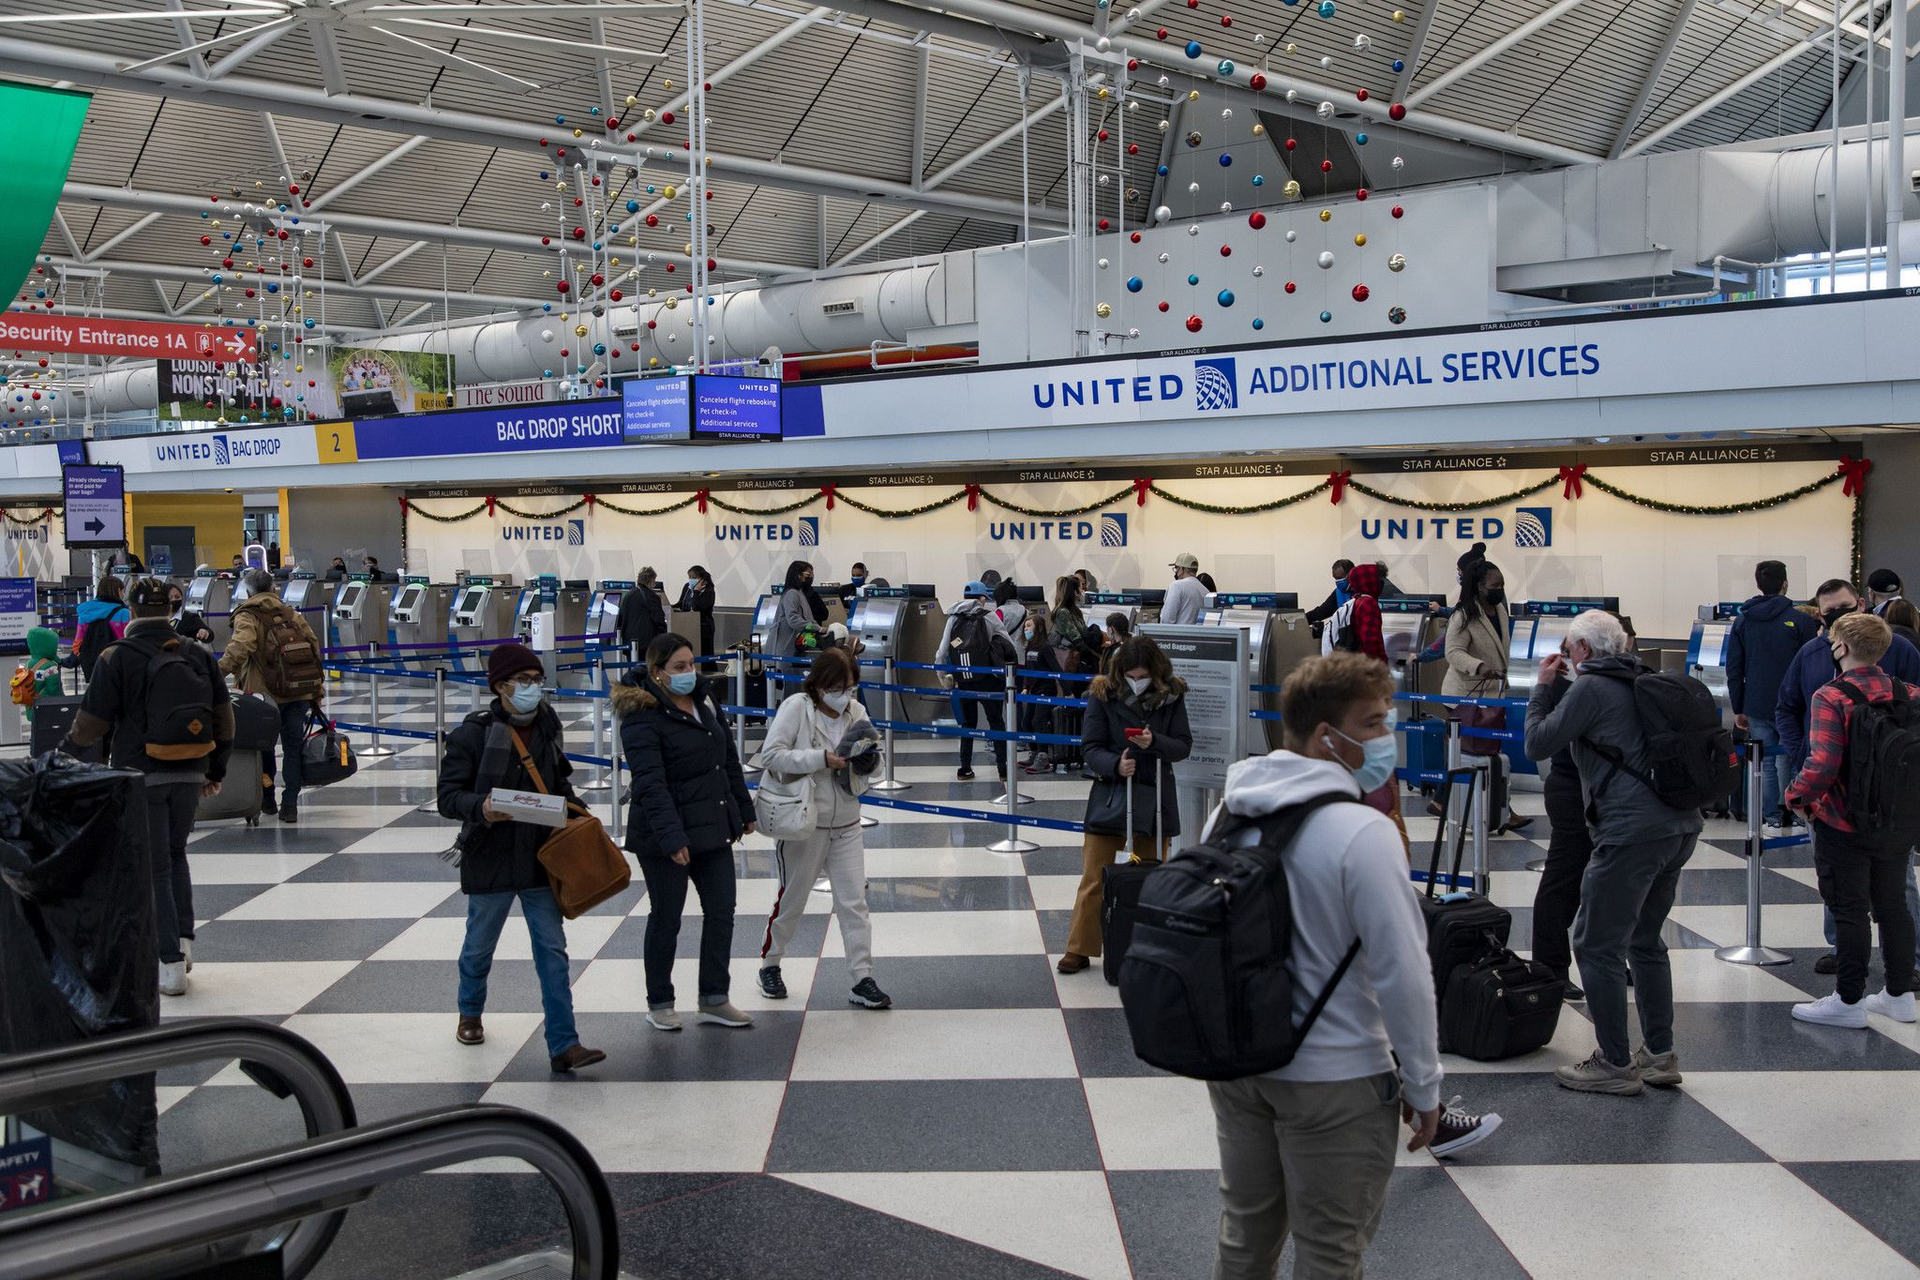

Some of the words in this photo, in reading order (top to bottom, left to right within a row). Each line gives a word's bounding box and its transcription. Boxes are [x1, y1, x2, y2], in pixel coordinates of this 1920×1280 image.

[1499, 321, 1532, 329] ALLIANCE
[0, 321, 72, 346] Security
[79, 328, 158, 348] Entrance
[165, 334, 188, 349] 1A
[1034, 374, 1183, 409] UNITED
[1249, 356, 1432, 395] ADDITIONAL
[1442, 344, 1600, 383] SERVICES
[172, 374, 242, 397] NONSTOP
[463, 382, 492, 406] The
[498, 376, 544, 403] sound
[662, 397, 686, 405] rebooking
[700, 396, 728, 404] Canceled
[729, 397, 745, 406] flight
[746, 398, 776, 407] rebooking
[496, 420, 525, 441] BAG
[528, 418, 567, 439] DROP
[572, 414, 621, 437] SHORT
[332, 433, 340, 452] 2
[157, 443, 211, 461] UNITED
[232, 441, 251, 456] BAG
[254, 438, 280, 454] DROP
[1650, 451, 1687, 462] STAR
[1689, 449, 1759, 461] ALLIANCE
[1402, 460, 1432, 470] STAR
[1434, 457, 1493, 468] ALLIANCE
[1020, 472, 1040, 480] STAR
[1041, 470, 1085, 480] ALLIANCE
[1196, 467, 1222, 476] STAR
[1223, 465, 1271, 474] ALLIANCE
[869, 477, 888, 485] STAR
[890, 476, 925, 484] ALLIANCE
[8, 530, 38, 540] UNITED
[503, 526, 564, 540] UNITED
[715, 524, 793, 540] UNITED
[990, 522, 1093, 540] UNITED
[1361, 518, 1504, 540] UNITED
[1172, 643, 1196, 651] Baggage
[1201, 756, 1225, 764] priority
